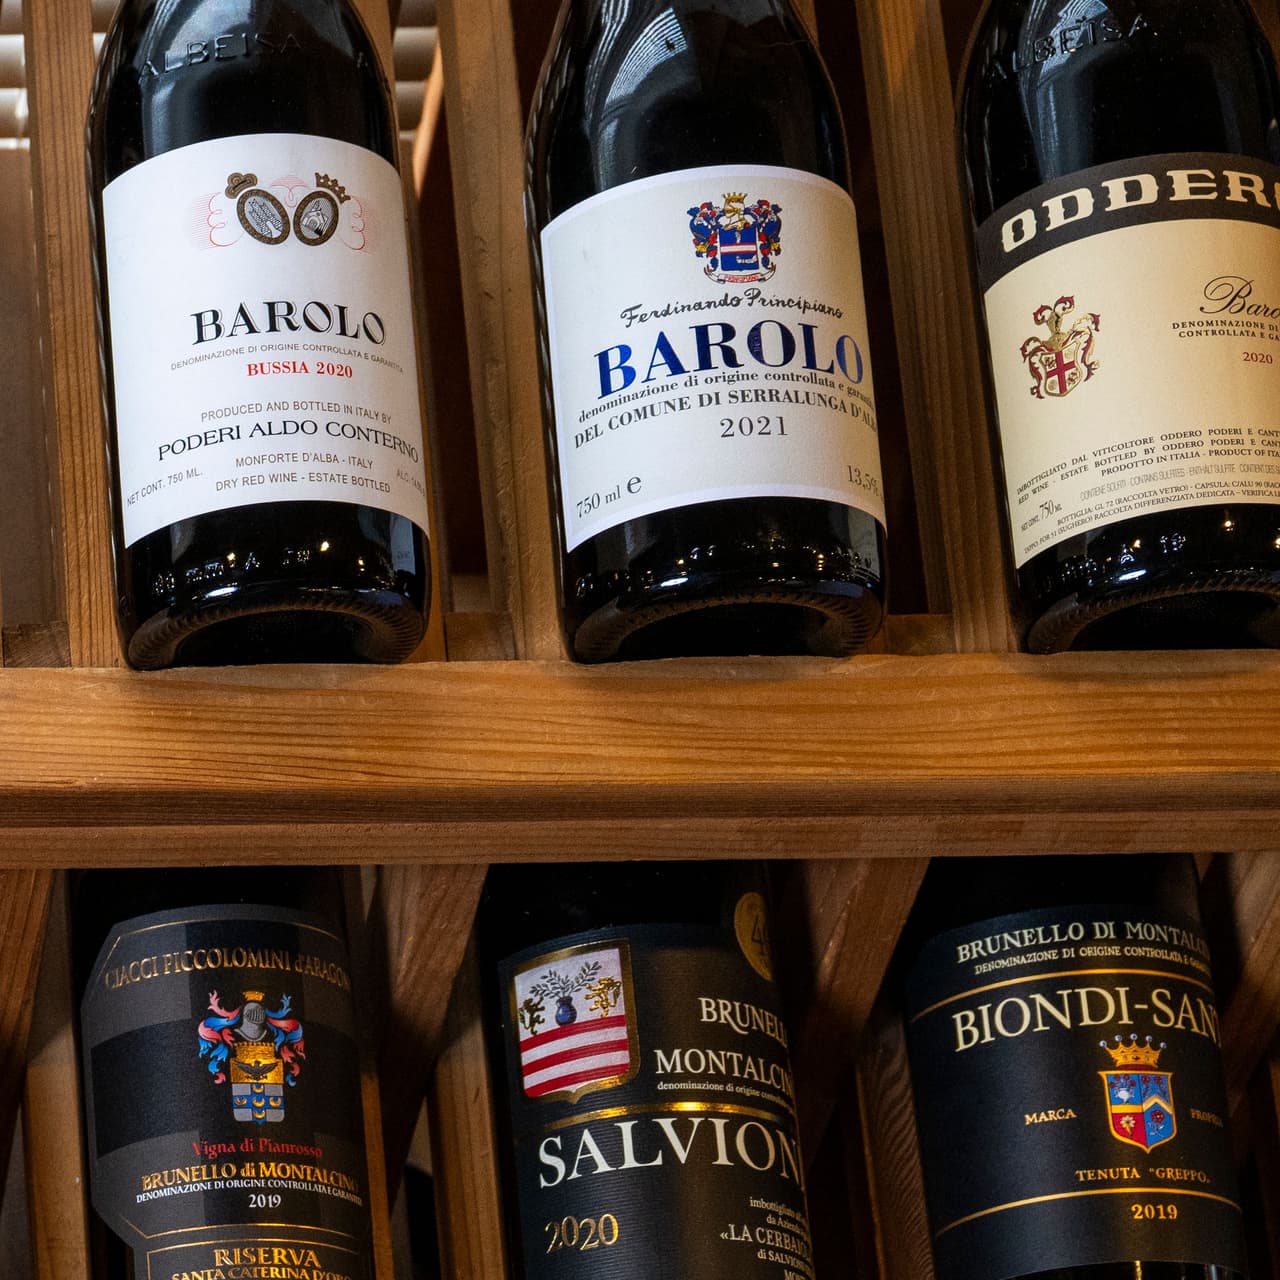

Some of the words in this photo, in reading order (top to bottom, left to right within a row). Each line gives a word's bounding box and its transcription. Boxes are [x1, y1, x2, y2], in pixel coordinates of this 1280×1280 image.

[1001, 169, 1280, 253] ODDER
[620, 294, 743, 329] Ferdinando
[744, 287, 844, 320] Principiano
[189, 300, 386, 347] BAROLO
[594, 319, 864, 400] BAROLO
[1242, 351, 1273, 365] 2020
[247, 361, 310, 377] BUSSIA
[316, 362, 354, 379] 2020
[720, 415, 788, 439] 2021
[158, 425, 242, 461] PODERI
[248, 419, 318, 439] ALDO
[325, 420, 419, 464] CONTERNO
[1024, 1109, 1077, 1126] MARCA
[1075, 1167, 1141, 1182] TENUTA
[248, 1194, 282, 1208] 2019
[1131, 1204, 1179, 1220] 2019
[544, 1213, 619, 1255] 2020
[214, 1246, 322, 1269] RISERVA
[228, 1265, 309, 1280] CATERINA
